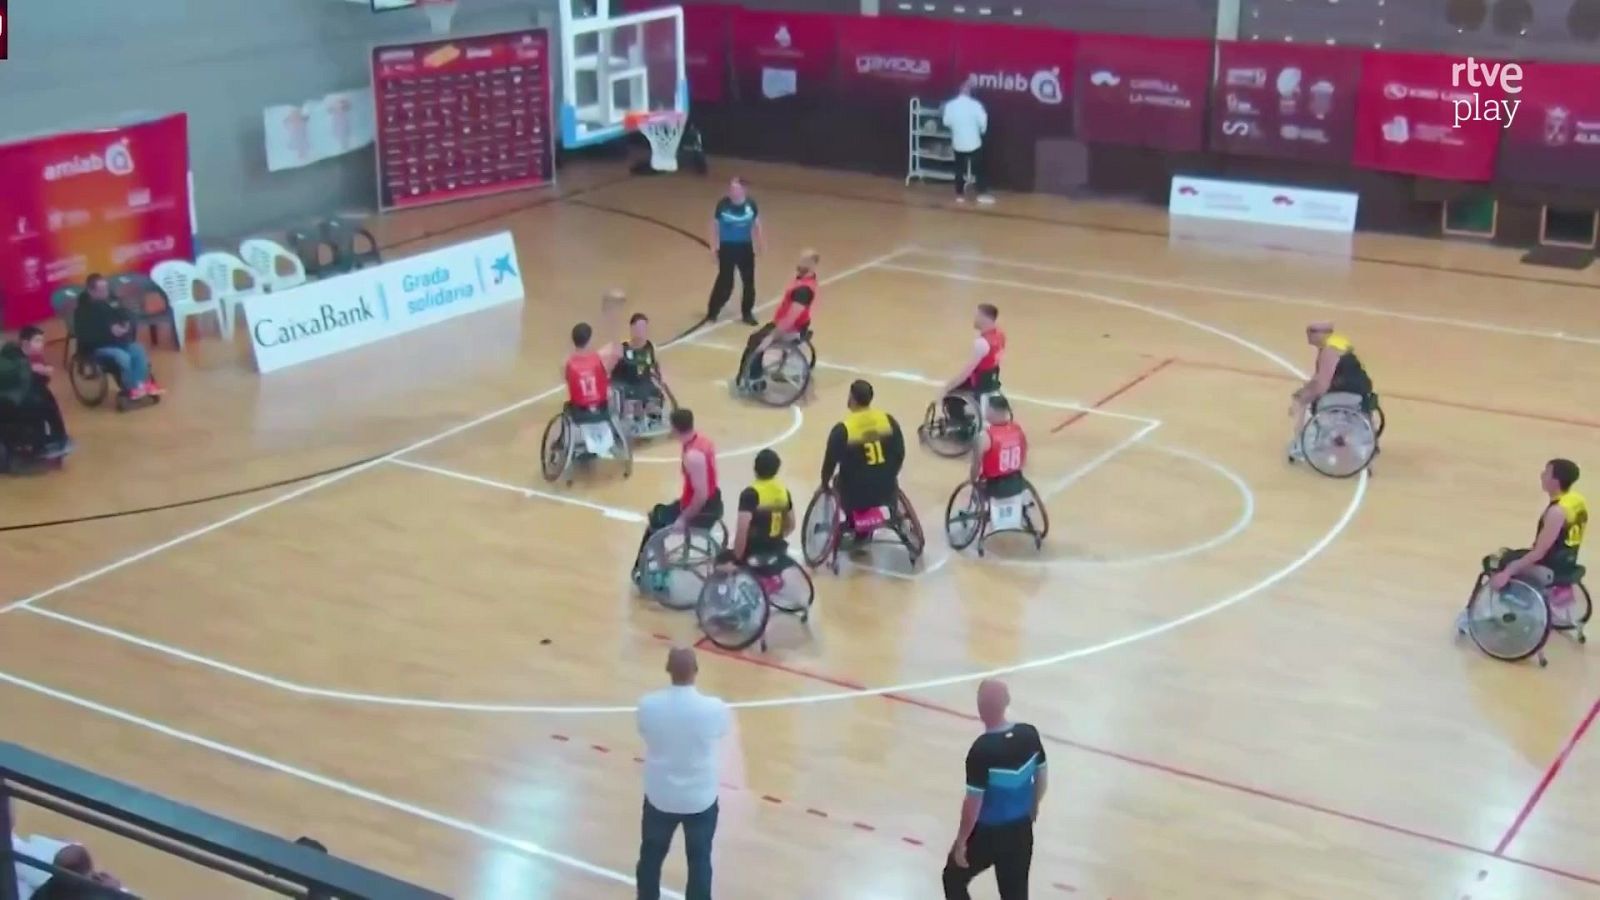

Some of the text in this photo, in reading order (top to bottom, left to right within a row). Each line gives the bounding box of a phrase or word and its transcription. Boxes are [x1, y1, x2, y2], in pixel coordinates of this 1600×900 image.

[402, 266, 450, 292] Grada
[407, 283, 475, 315] solidaria
[253, 296, 375, 348] CaixaBank
[863, 440, 885, 466] 31
